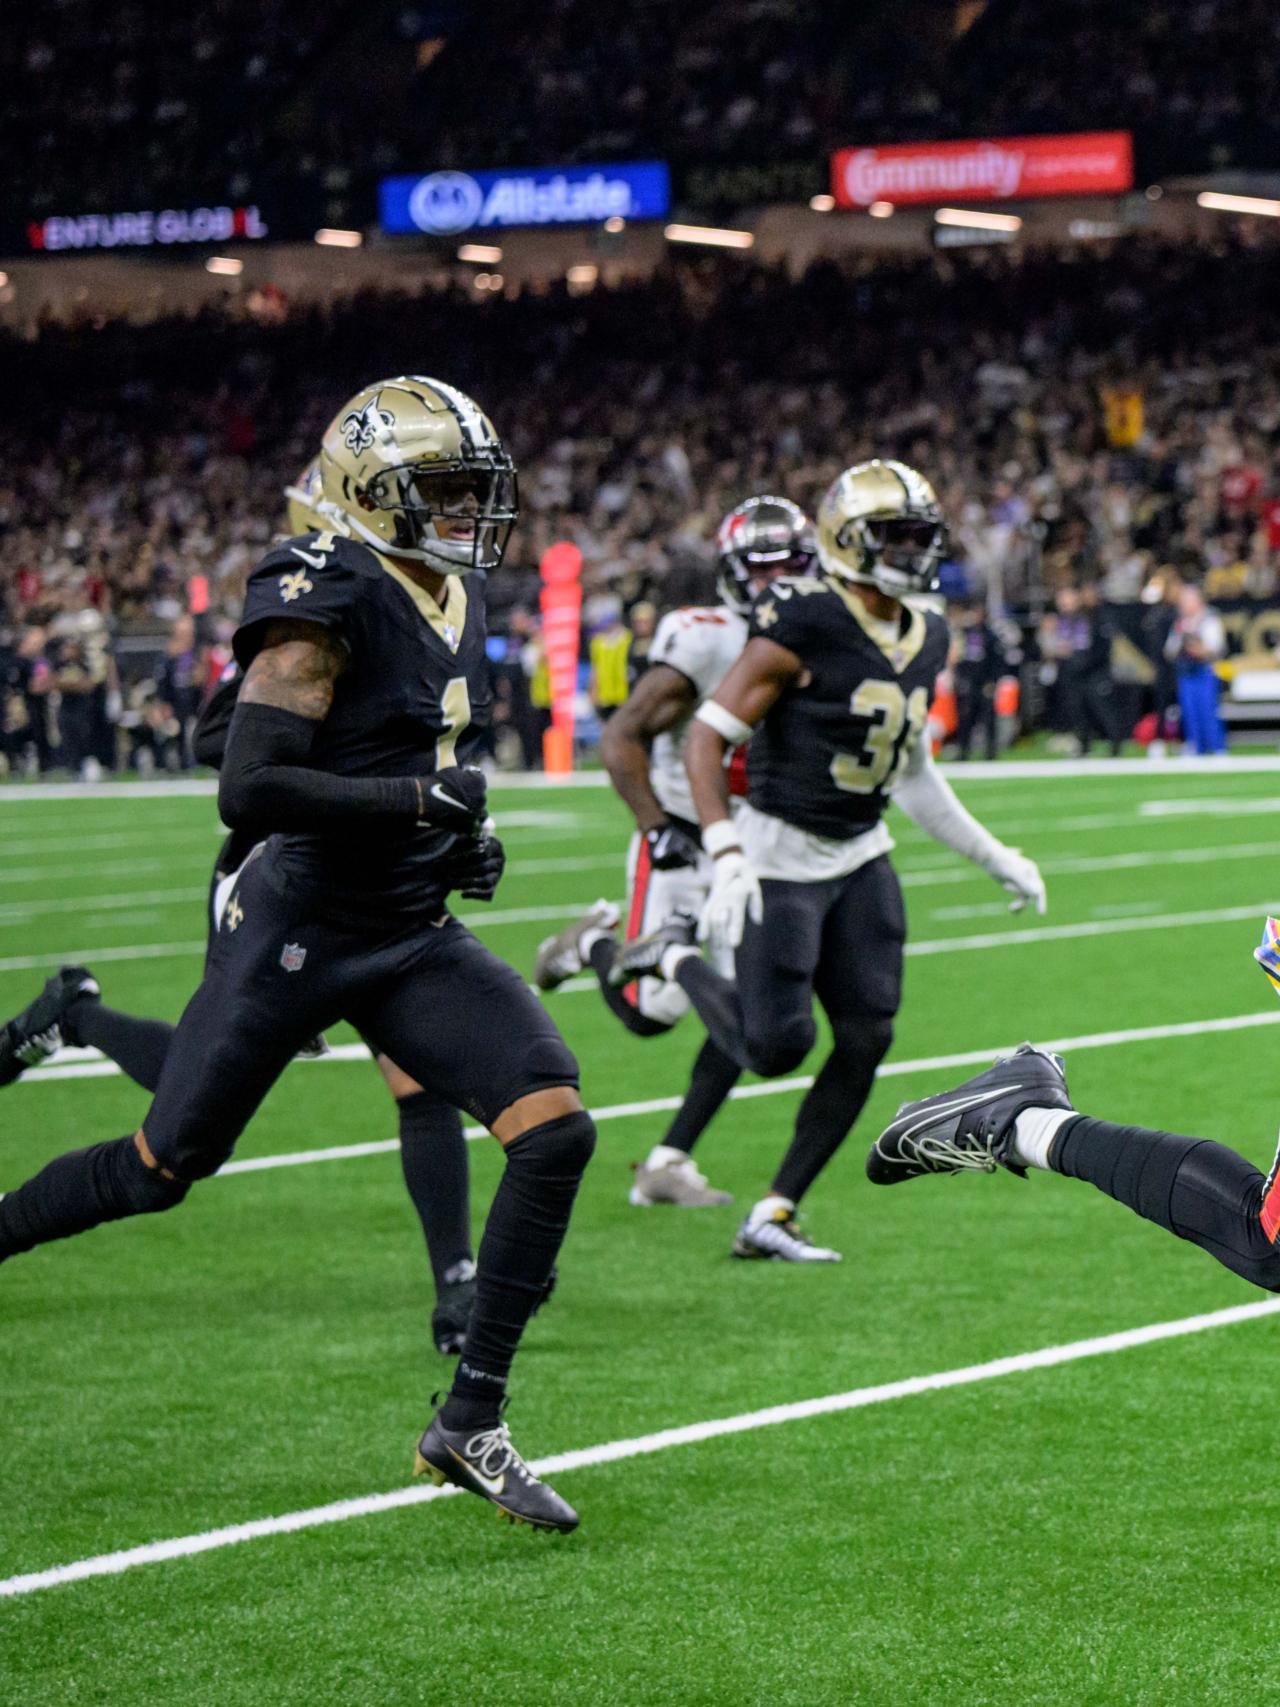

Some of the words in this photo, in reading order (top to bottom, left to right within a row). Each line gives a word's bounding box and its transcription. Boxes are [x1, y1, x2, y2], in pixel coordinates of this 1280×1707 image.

[478, 172, 631, 227] Allstate
[844, 142, 1024, 204] Community
[435, 676, 471, 772] 1
